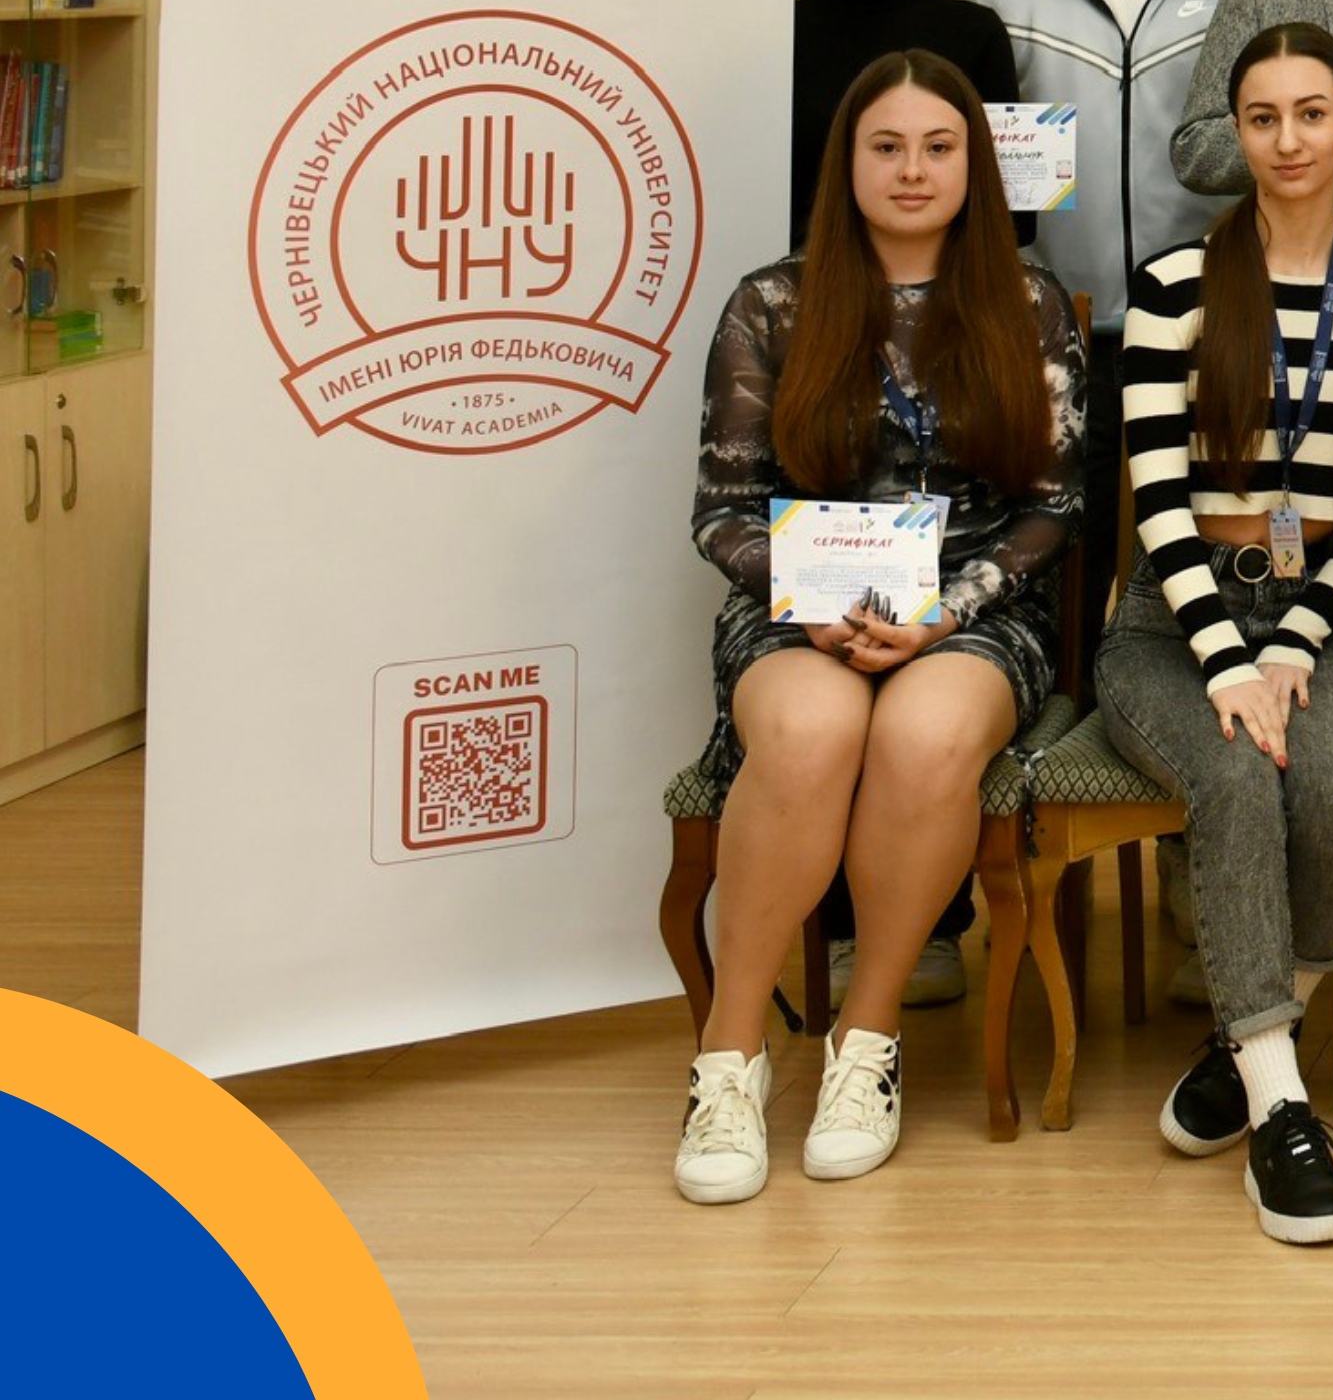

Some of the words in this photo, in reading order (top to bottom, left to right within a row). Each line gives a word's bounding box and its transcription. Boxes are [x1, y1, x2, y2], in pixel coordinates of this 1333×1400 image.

[285, 90, 376, 330] ЧЕРНІВЕЦЬКИЙ
[374, 41, 624, 115] НАЦІОНАЛЬНИЙ
[615, 107, 674, 308] УНІВЕРСИТЕТ
[318, 362, 394, 404] ІМЕНІ
[398, 340, 464, 374] ЮРІЯ
[470, 337, 635, 383] ФЕДЬКОВИЧА
[461, 392, 505, 409] 1875
[400, 411, 457, 436] VIVAT
[460, 401, 563, 436] ACADEMIA
[413, 669, 494, 698] SCAN
[499, 664, 541, 689] ME
